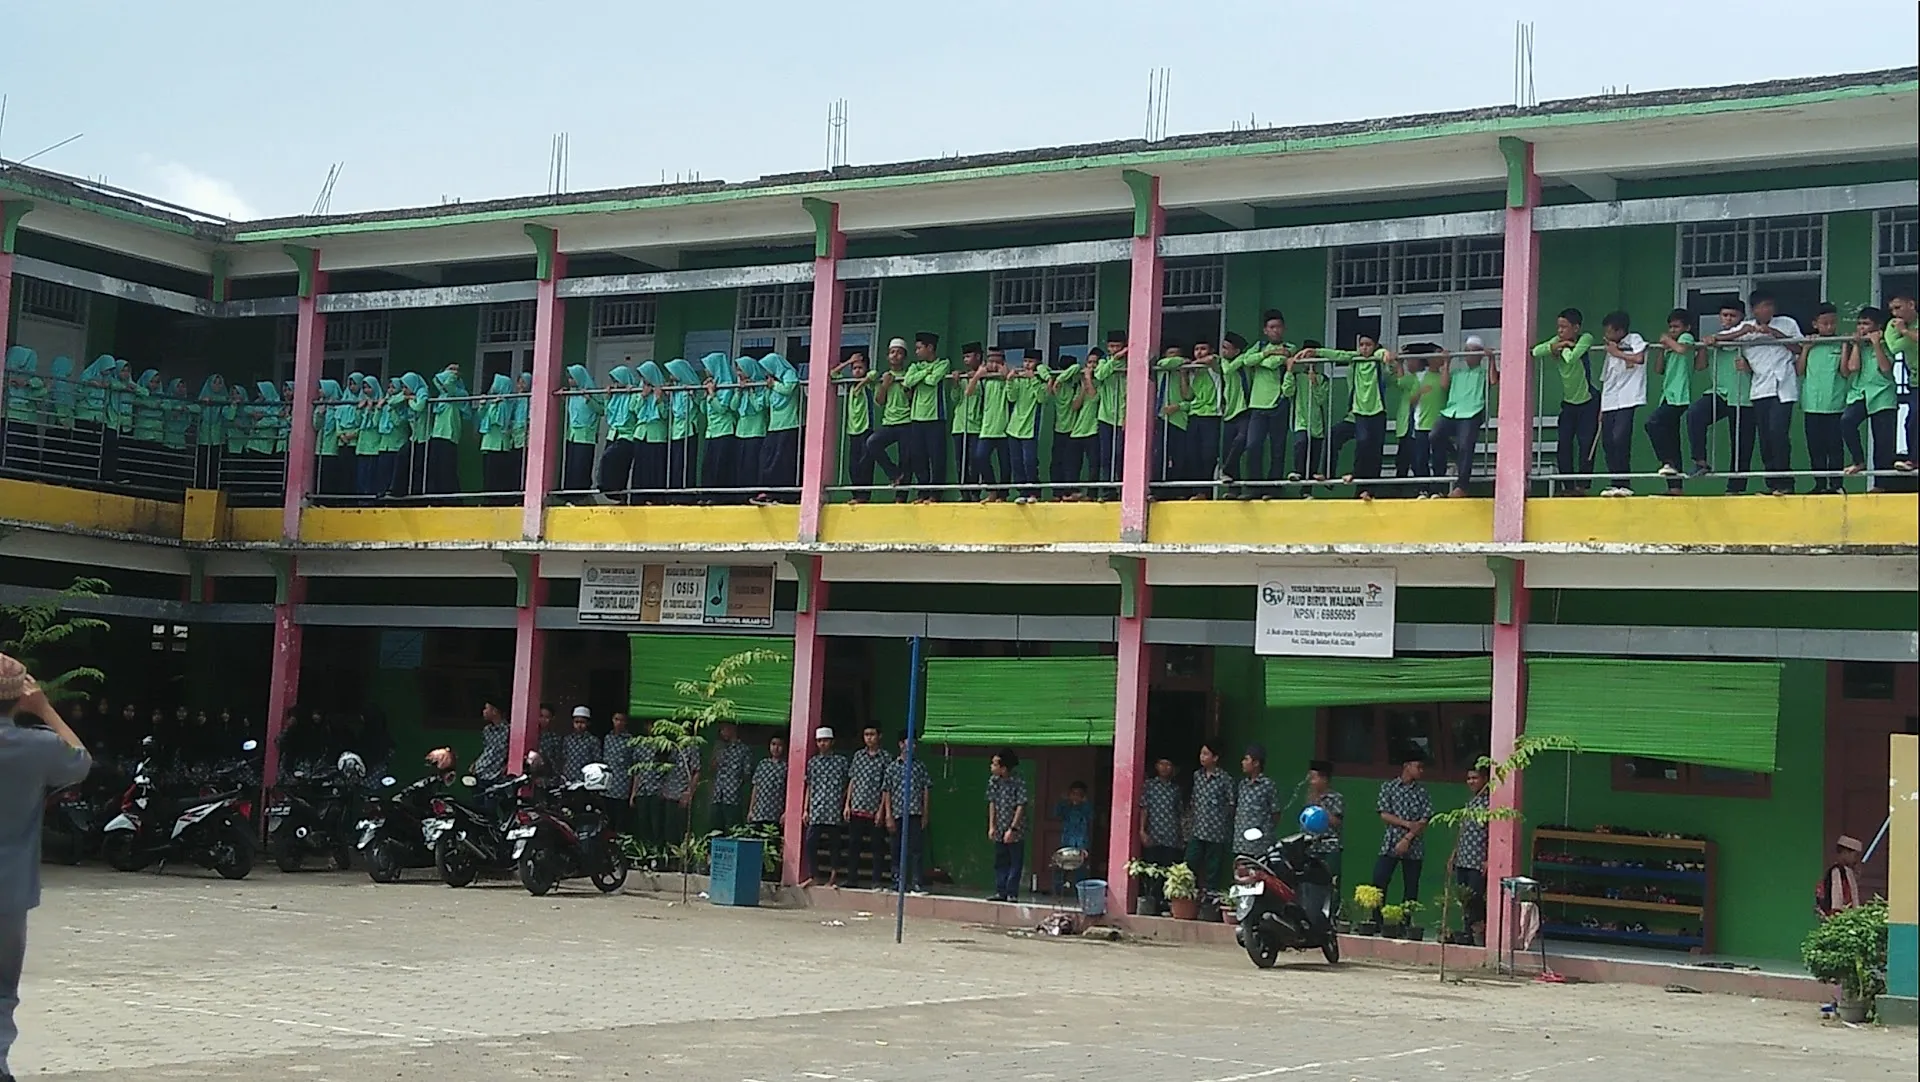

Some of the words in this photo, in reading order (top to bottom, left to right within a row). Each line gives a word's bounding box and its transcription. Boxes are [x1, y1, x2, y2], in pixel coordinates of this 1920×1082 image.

[1287, 595, 1305, 606] PAUD
[1307, 595, 1328, 607] BIRUL
[1329, 596, 1364, 607] WALIDAIN
[1293, 608, 1315, 619] NPSN
[1321, 609, 1356, 620] 69856095
